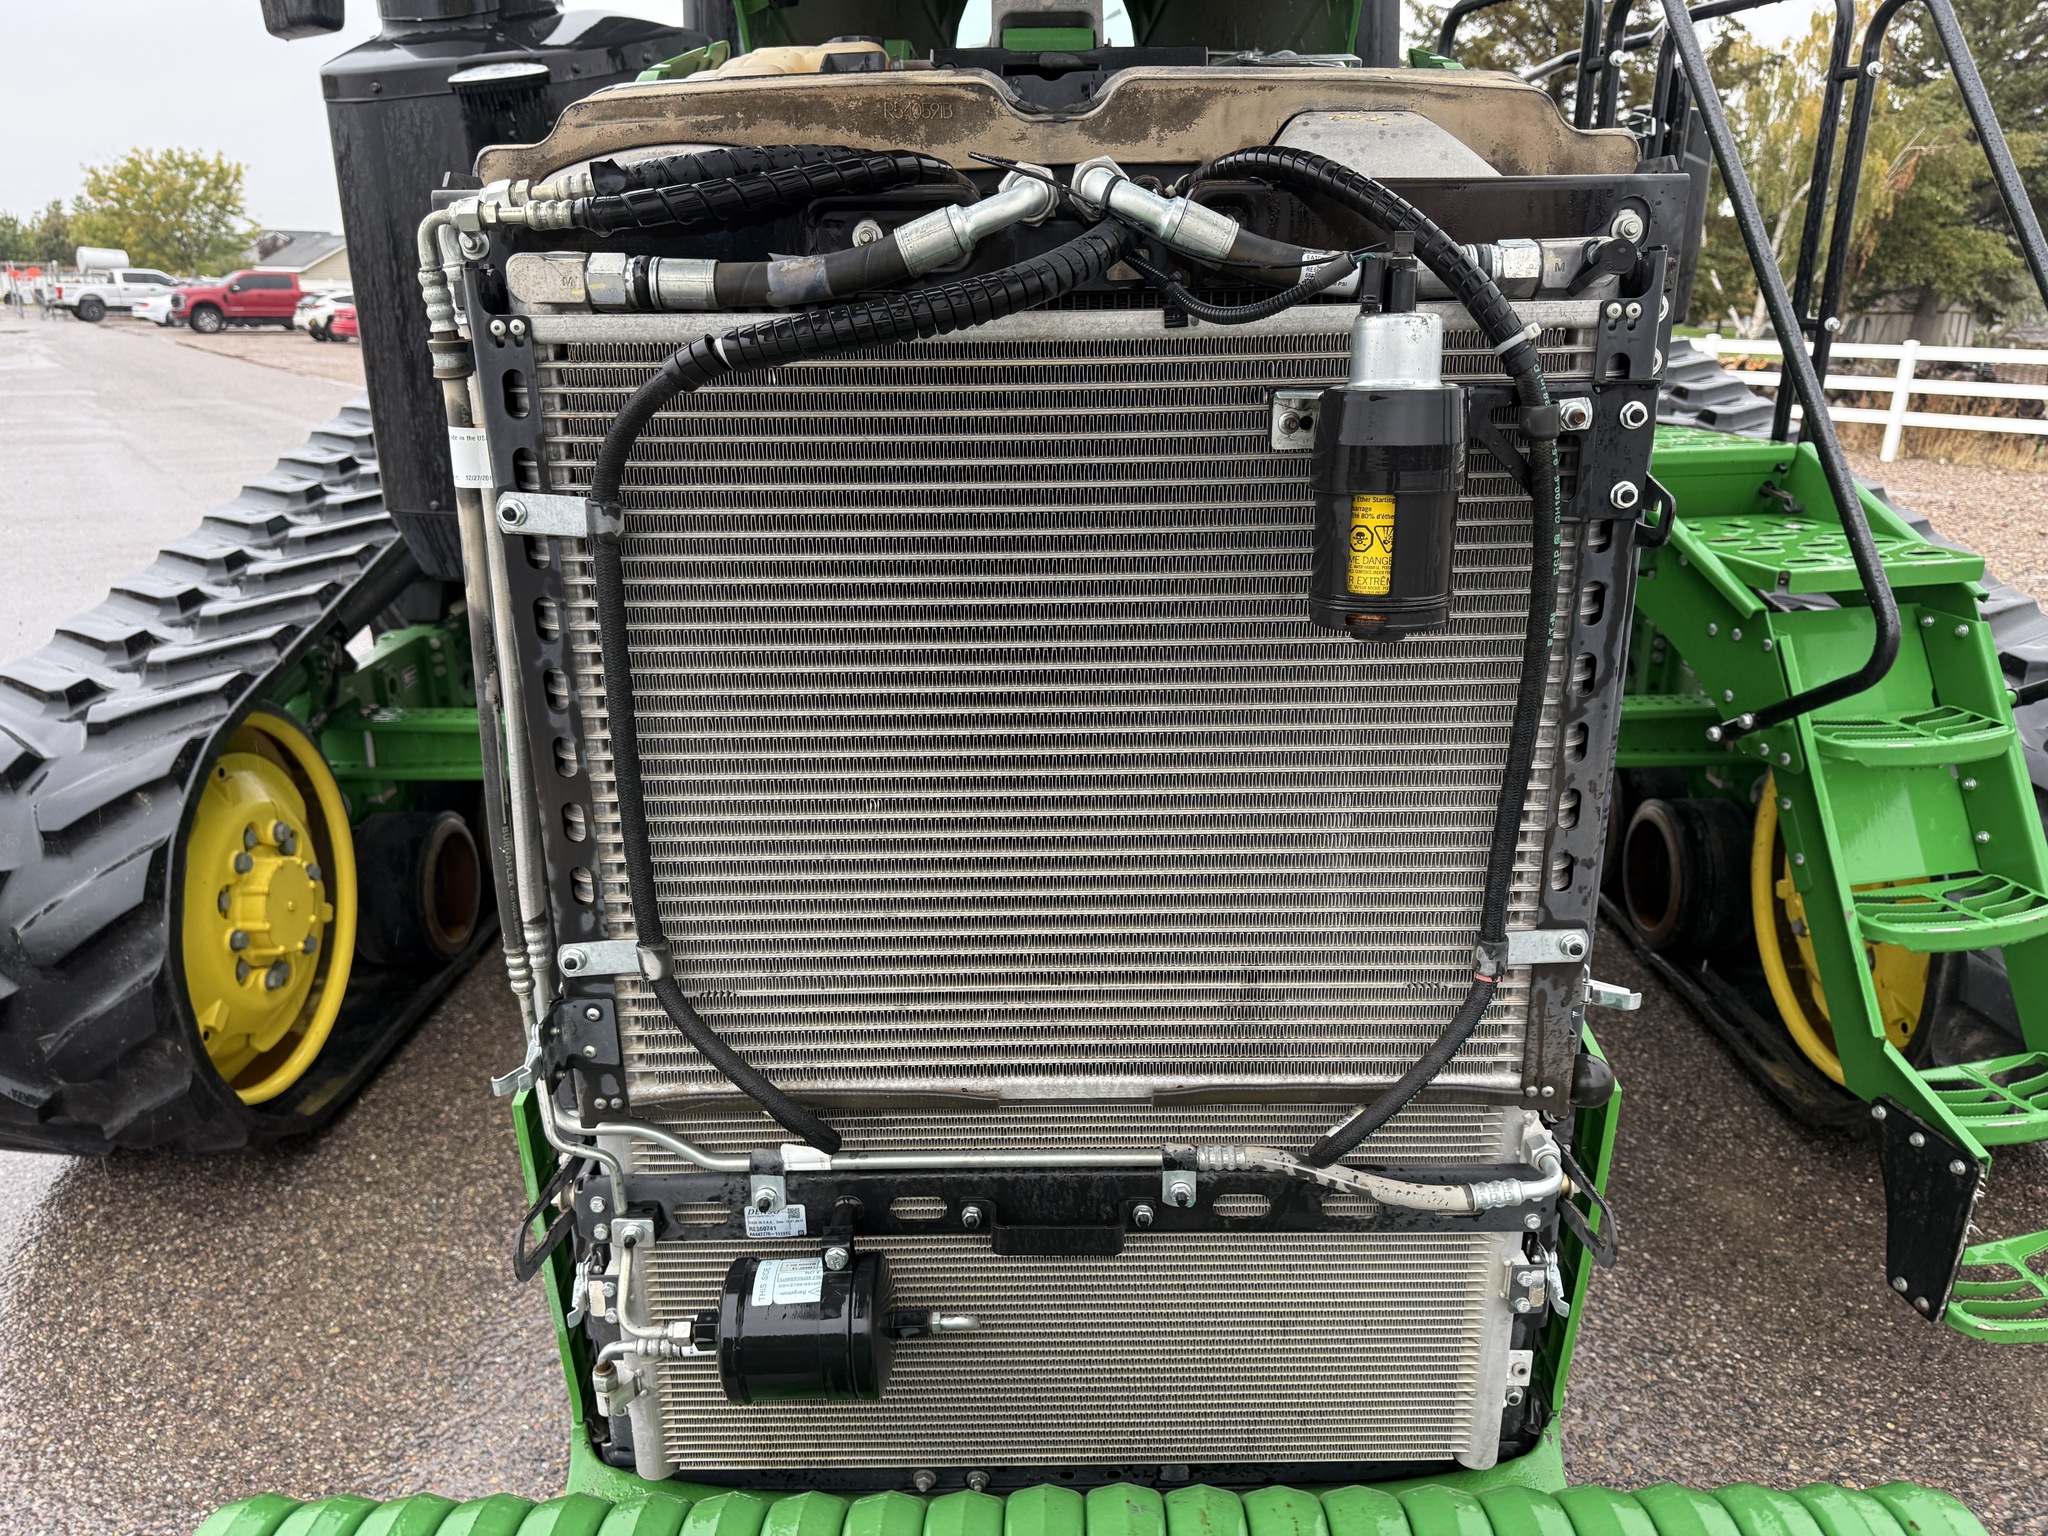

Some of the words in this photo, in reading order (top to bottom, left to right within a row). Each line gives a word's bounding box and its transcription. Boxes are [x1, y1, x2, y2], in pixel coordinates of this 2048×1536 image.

[1372, 496, 1396, 504] Starting
[761, 1266, 771, 1281] SIDE
[758, 1283, 767, 1302] THIS
